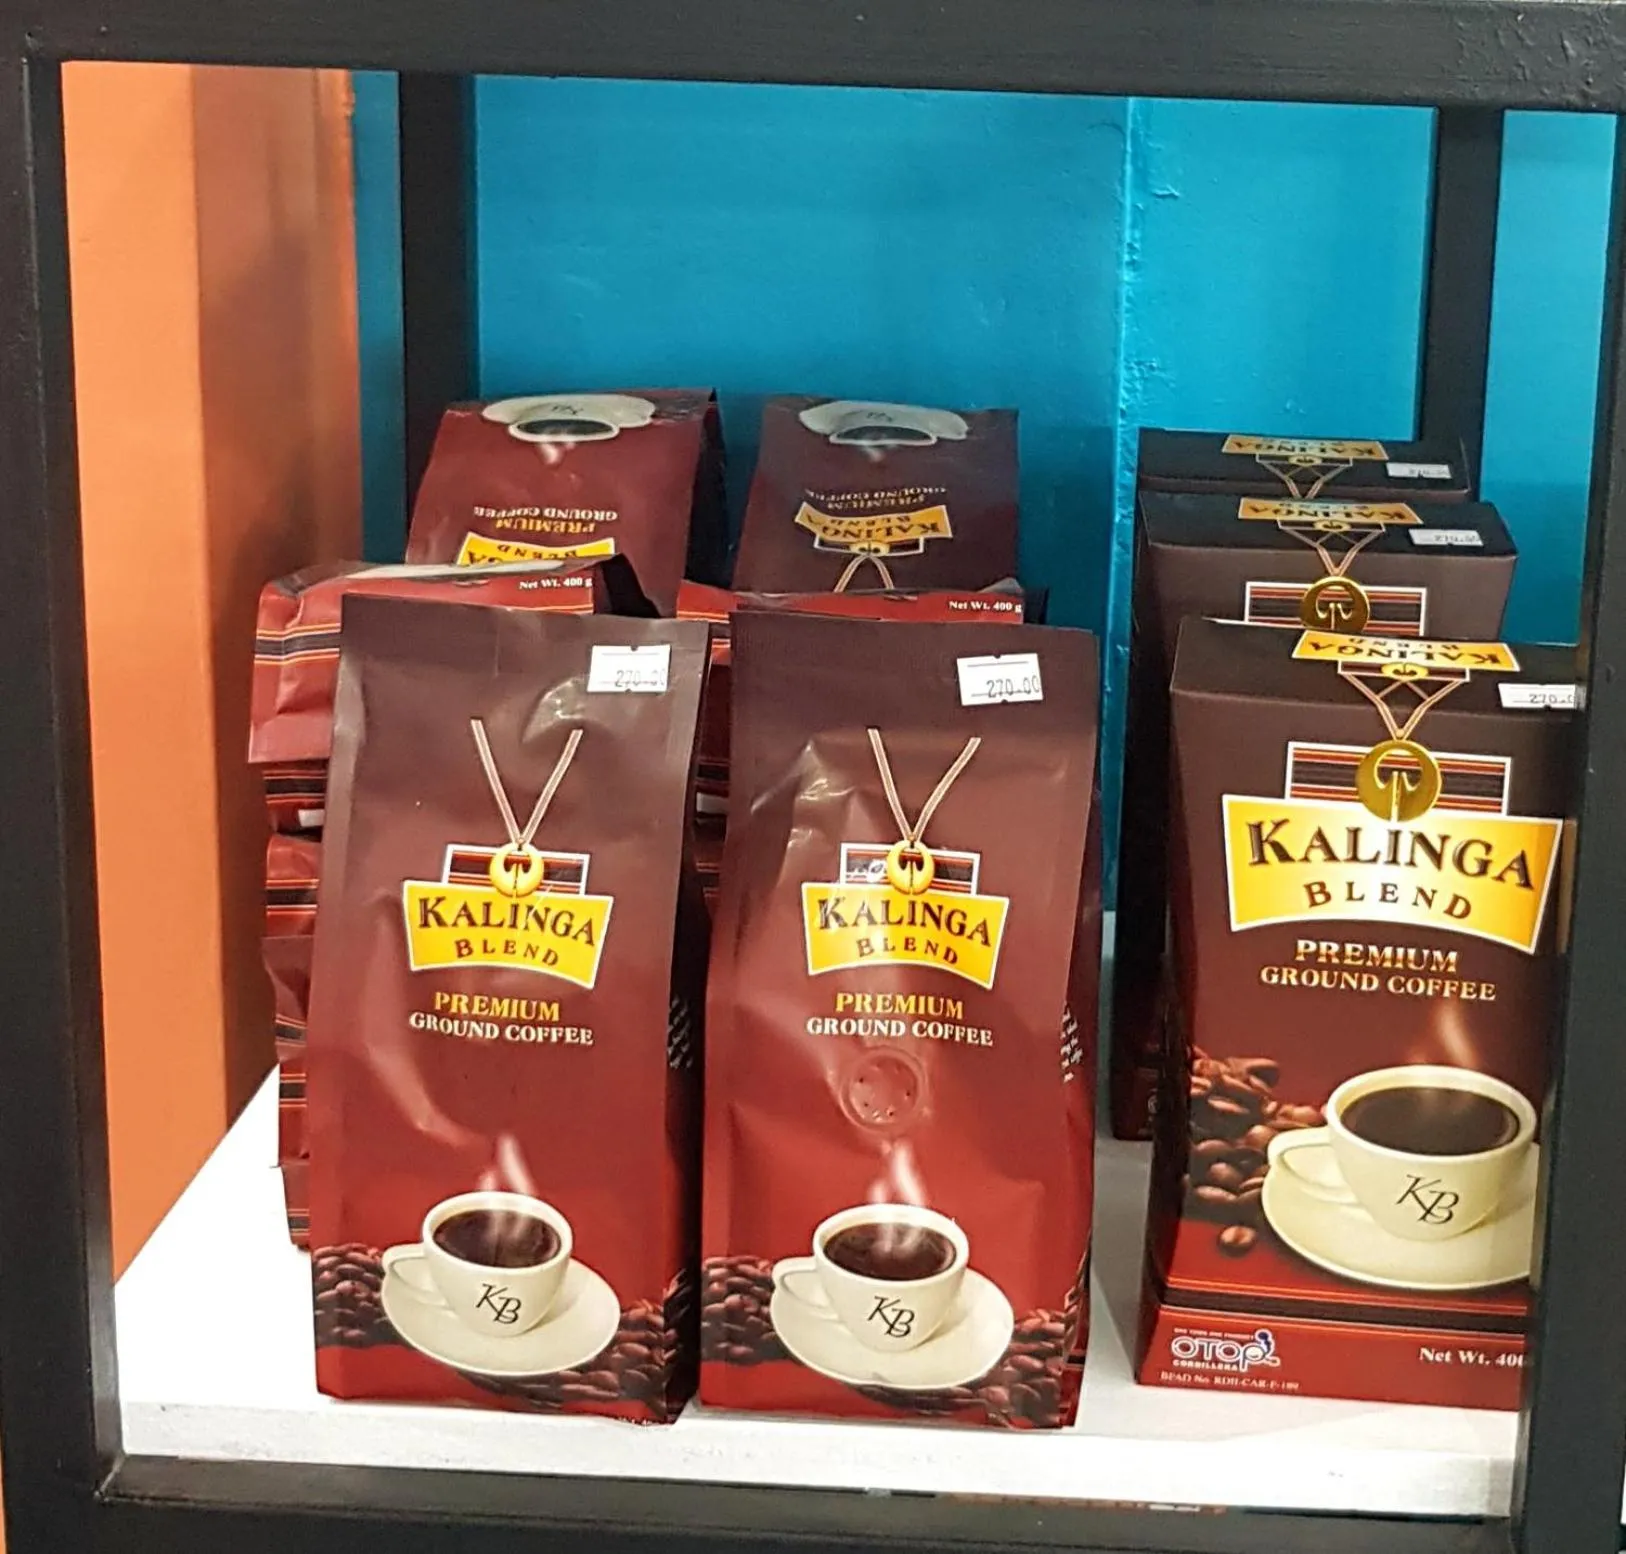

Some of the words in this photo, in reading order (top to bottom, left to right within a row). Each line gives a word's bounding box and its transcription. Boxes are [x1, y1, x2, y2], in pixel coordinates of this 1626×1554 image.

[474, 506, 540, 518] COFFEE
[495, 518, 596, 533] PREMIUM
[544, 508, 618, 521] GROUND
[519, 581, 538, 590] Net
[540, 578, 561, 588] Wt.
[563, 577, 583, 587] 400
[585, 578, 593, 588] g
[948, 600, 968, 610] Net
[970, 601, 991, 611] Wt.
[993, 601, 1013, 611] 400
[1014, 604, 1022, 613] g
[1310, 641, 1501, 665] KALINGA
[1349, 637, 1458, 650] BLEND
[986, 675, 1040, 698] 270.00
[1246, 818, 1534, 890] KALINGA
[1303, 880, 1472, 920] BLEND
[418, 896, 595, 947] KALINGA
[817, 898, 991, 948] KALINGA
[455, 938, 559, 967] BLEND
[856, 937, 959, 965] BLEND
[1294, 939, 1457, 973] PREMIUM
[1260, 965, 1379, 993] GROUND
[1387, 975, 1497, 1001] COFFEE
[435, 991, 560, 1022] PREMIUM
[835, 992, 964, 1020] PREMIUM
[409, 1011, 499, 1040] GROUND
[504, 1024, 594, 1046] COFFEE
[806, 1016, 905, 1038] GROUND
[911, 1020, 994, 1047] COFFEE
[1395, 1174, 1459, 1225] KB
[475, 1283, 523, 1326] KB
[867, 1295, 916, 1339] KB
[1173, 1359, 1238, 1372] CORDILLERA
[1419, 1347, 1452, 1363] Net
[1458, 1350, 1490, 1366] Wt.
